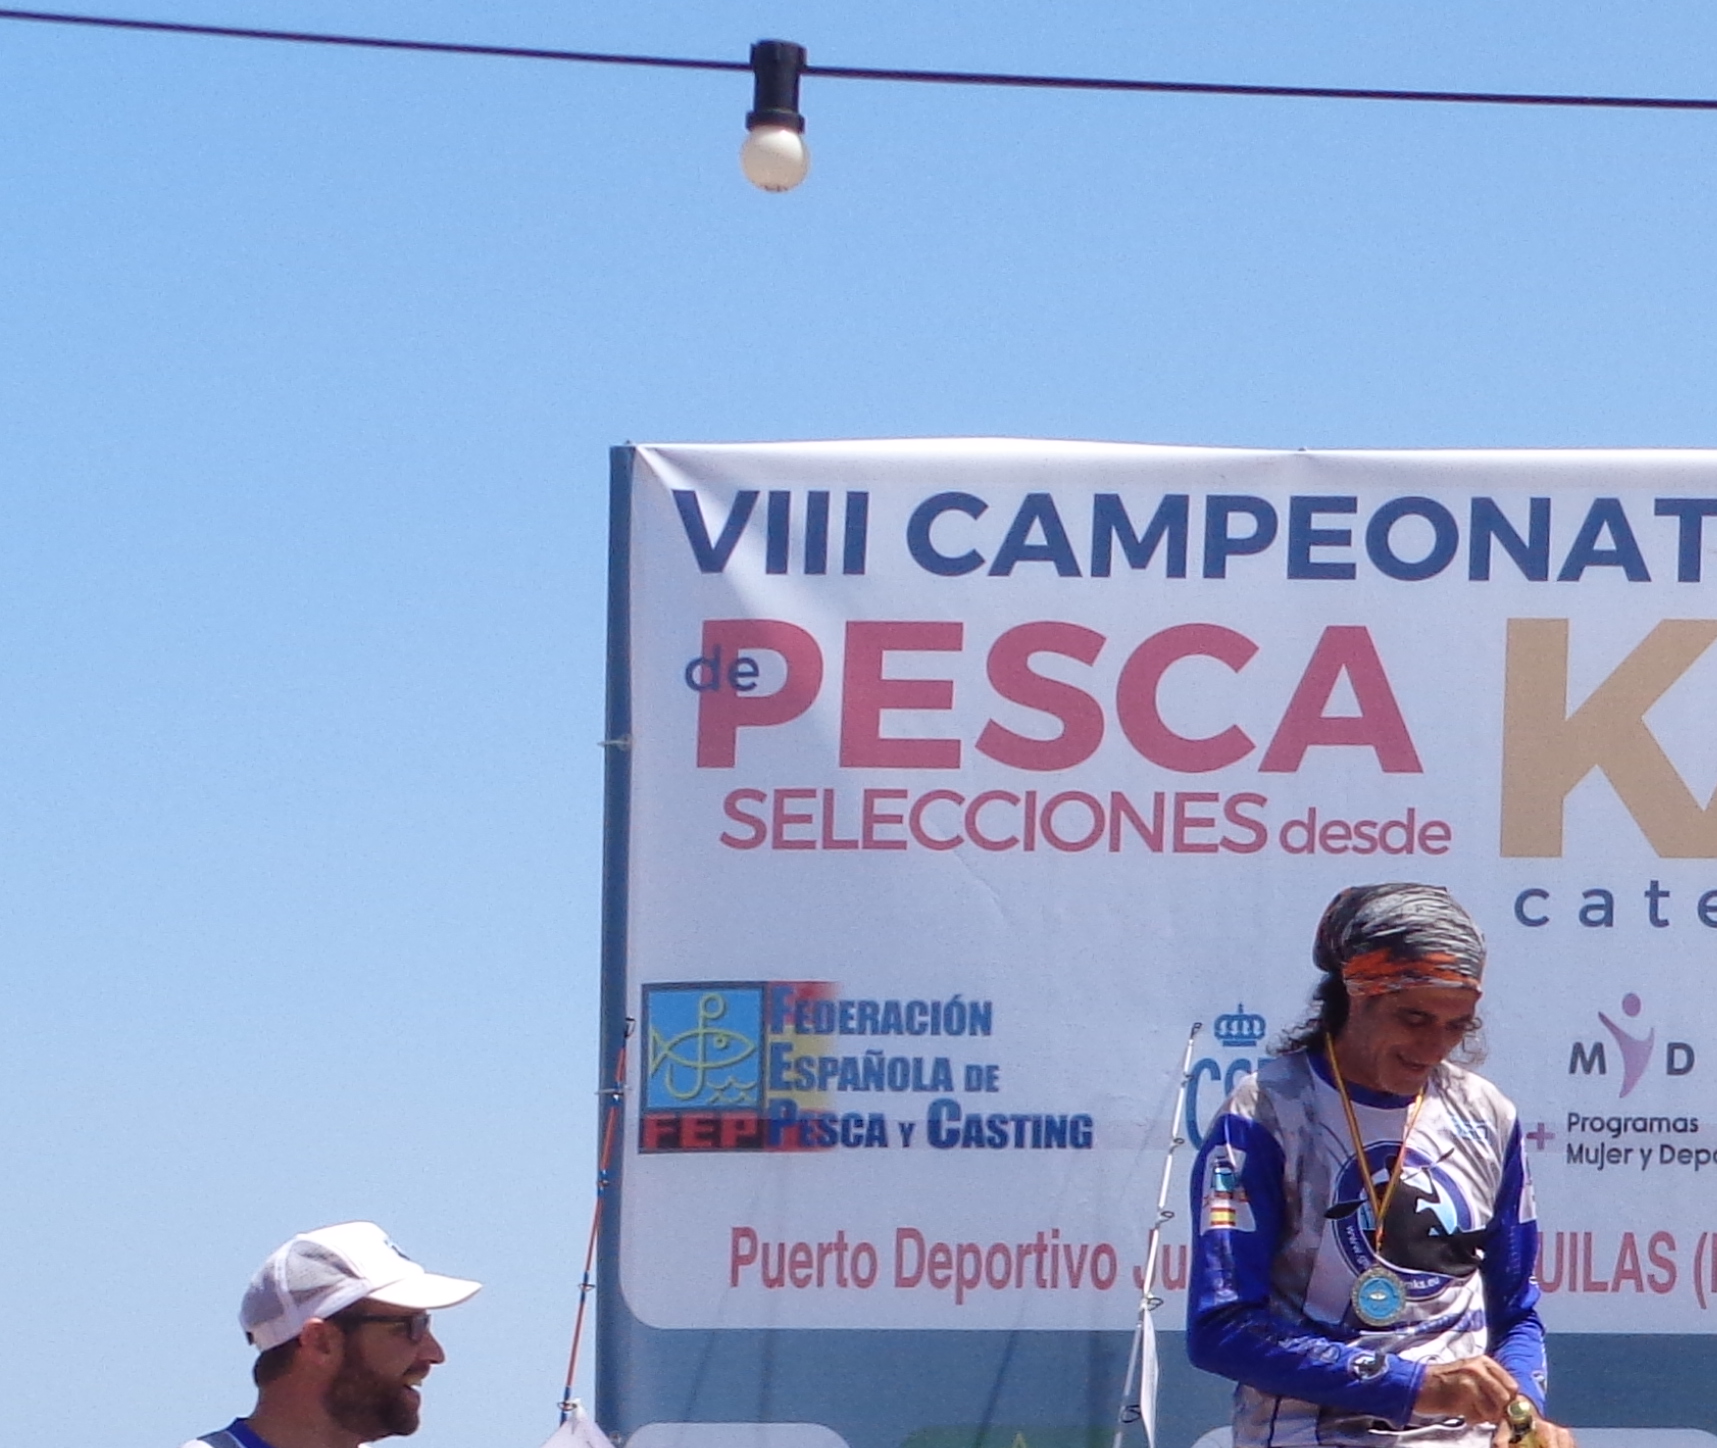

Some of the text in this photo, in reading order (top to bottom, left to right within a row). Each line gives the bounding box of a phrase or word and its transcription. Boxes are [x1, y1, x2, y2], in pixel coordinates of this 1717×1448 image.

[673, 489, 868, 576] VIII
[684, 618, 1424, 774] de PESCA
[719, 788, 1452, 856] SELECCIONES desde
[768, 992, 993, 1037] FEDERACIÓN
[768, 1041, 1000, 1092] ESPAÑOLA DE
[642, 1113, 757, 1151] FEP
[767, 1098, 1093, 1150] PESCA CASTING
[1567, 1112, 1699, 1137] Programas
[1566, 1143, 1633, 1170] Mujer
[1639, 1147, 1653, 1169] y
[730, 1226, 878, 1290] Puerto
[894, 1228, 1119, 1306] Deportivo
